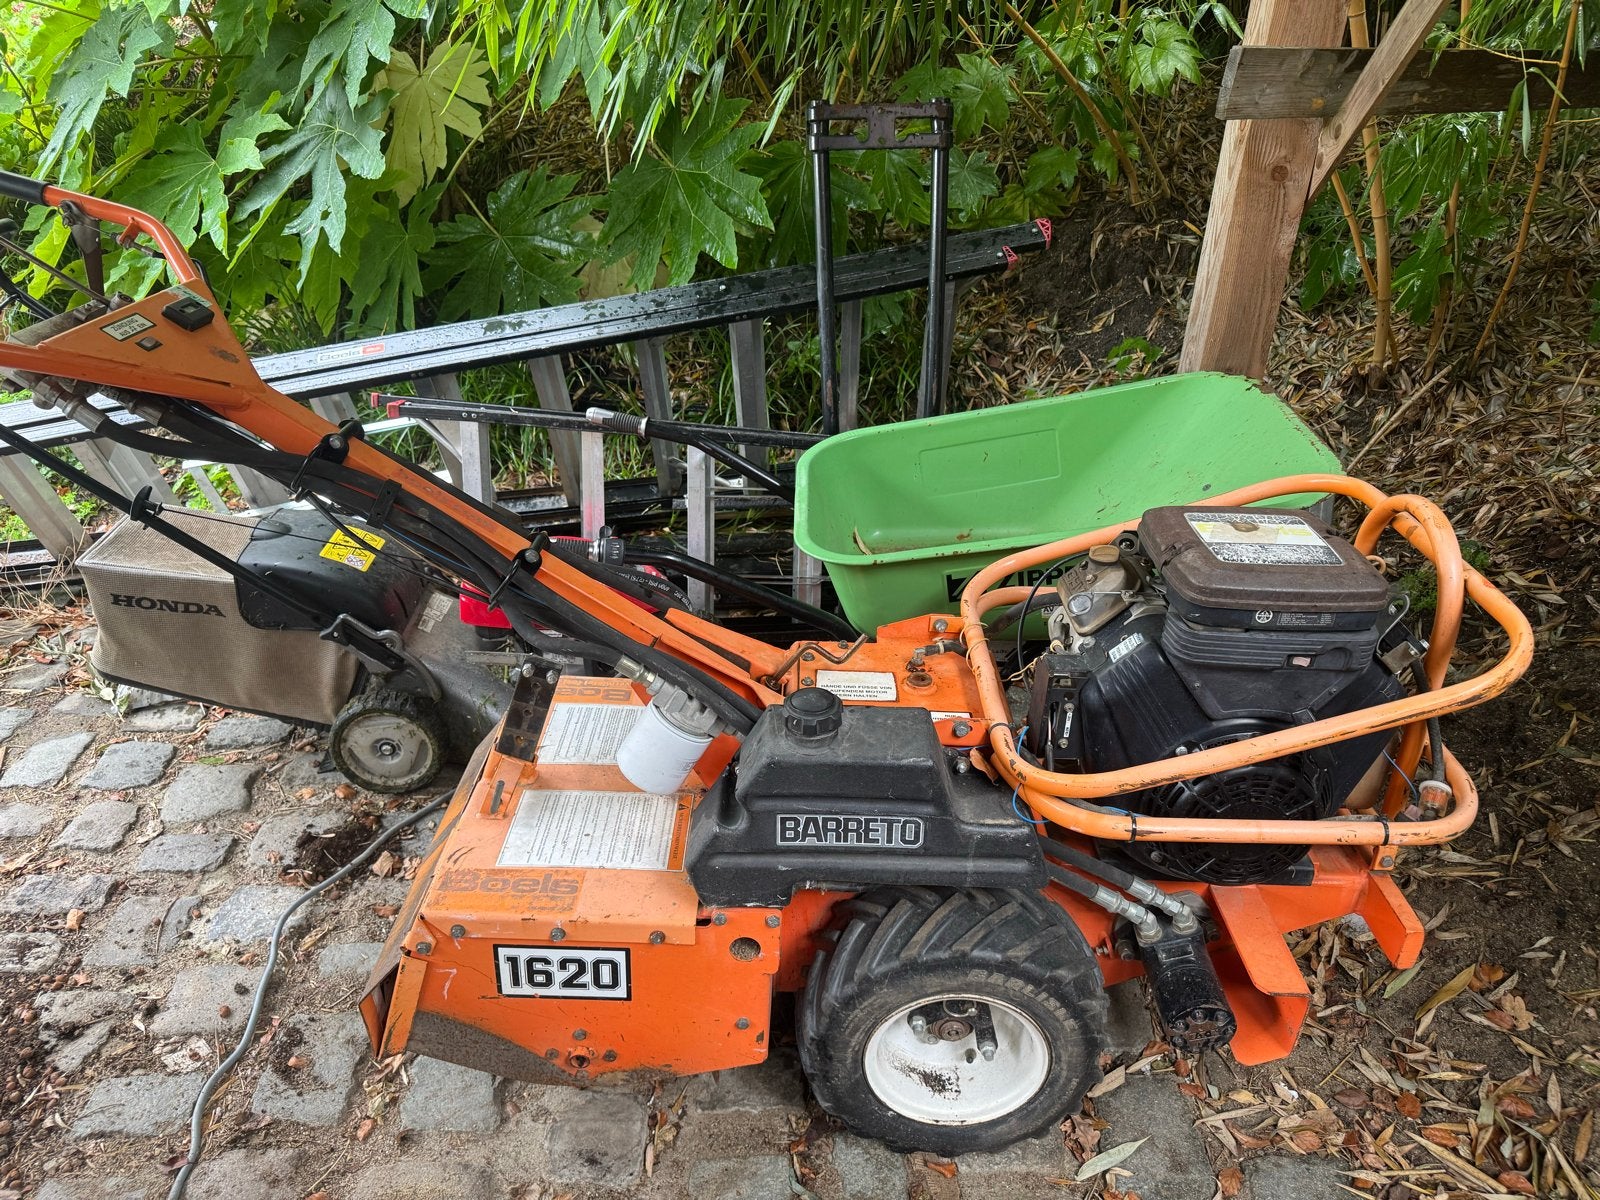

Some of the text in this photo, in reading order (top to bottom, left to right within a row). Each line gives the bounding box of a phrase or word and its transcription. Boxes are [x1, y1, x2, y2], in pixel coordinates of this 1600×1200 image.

[110, 593, 226, 618] HONDA
[777, 814, 924, 848] BARRETO
[437, 870, 580, 896] Boels
[504, 954, 622, 991] 1620
